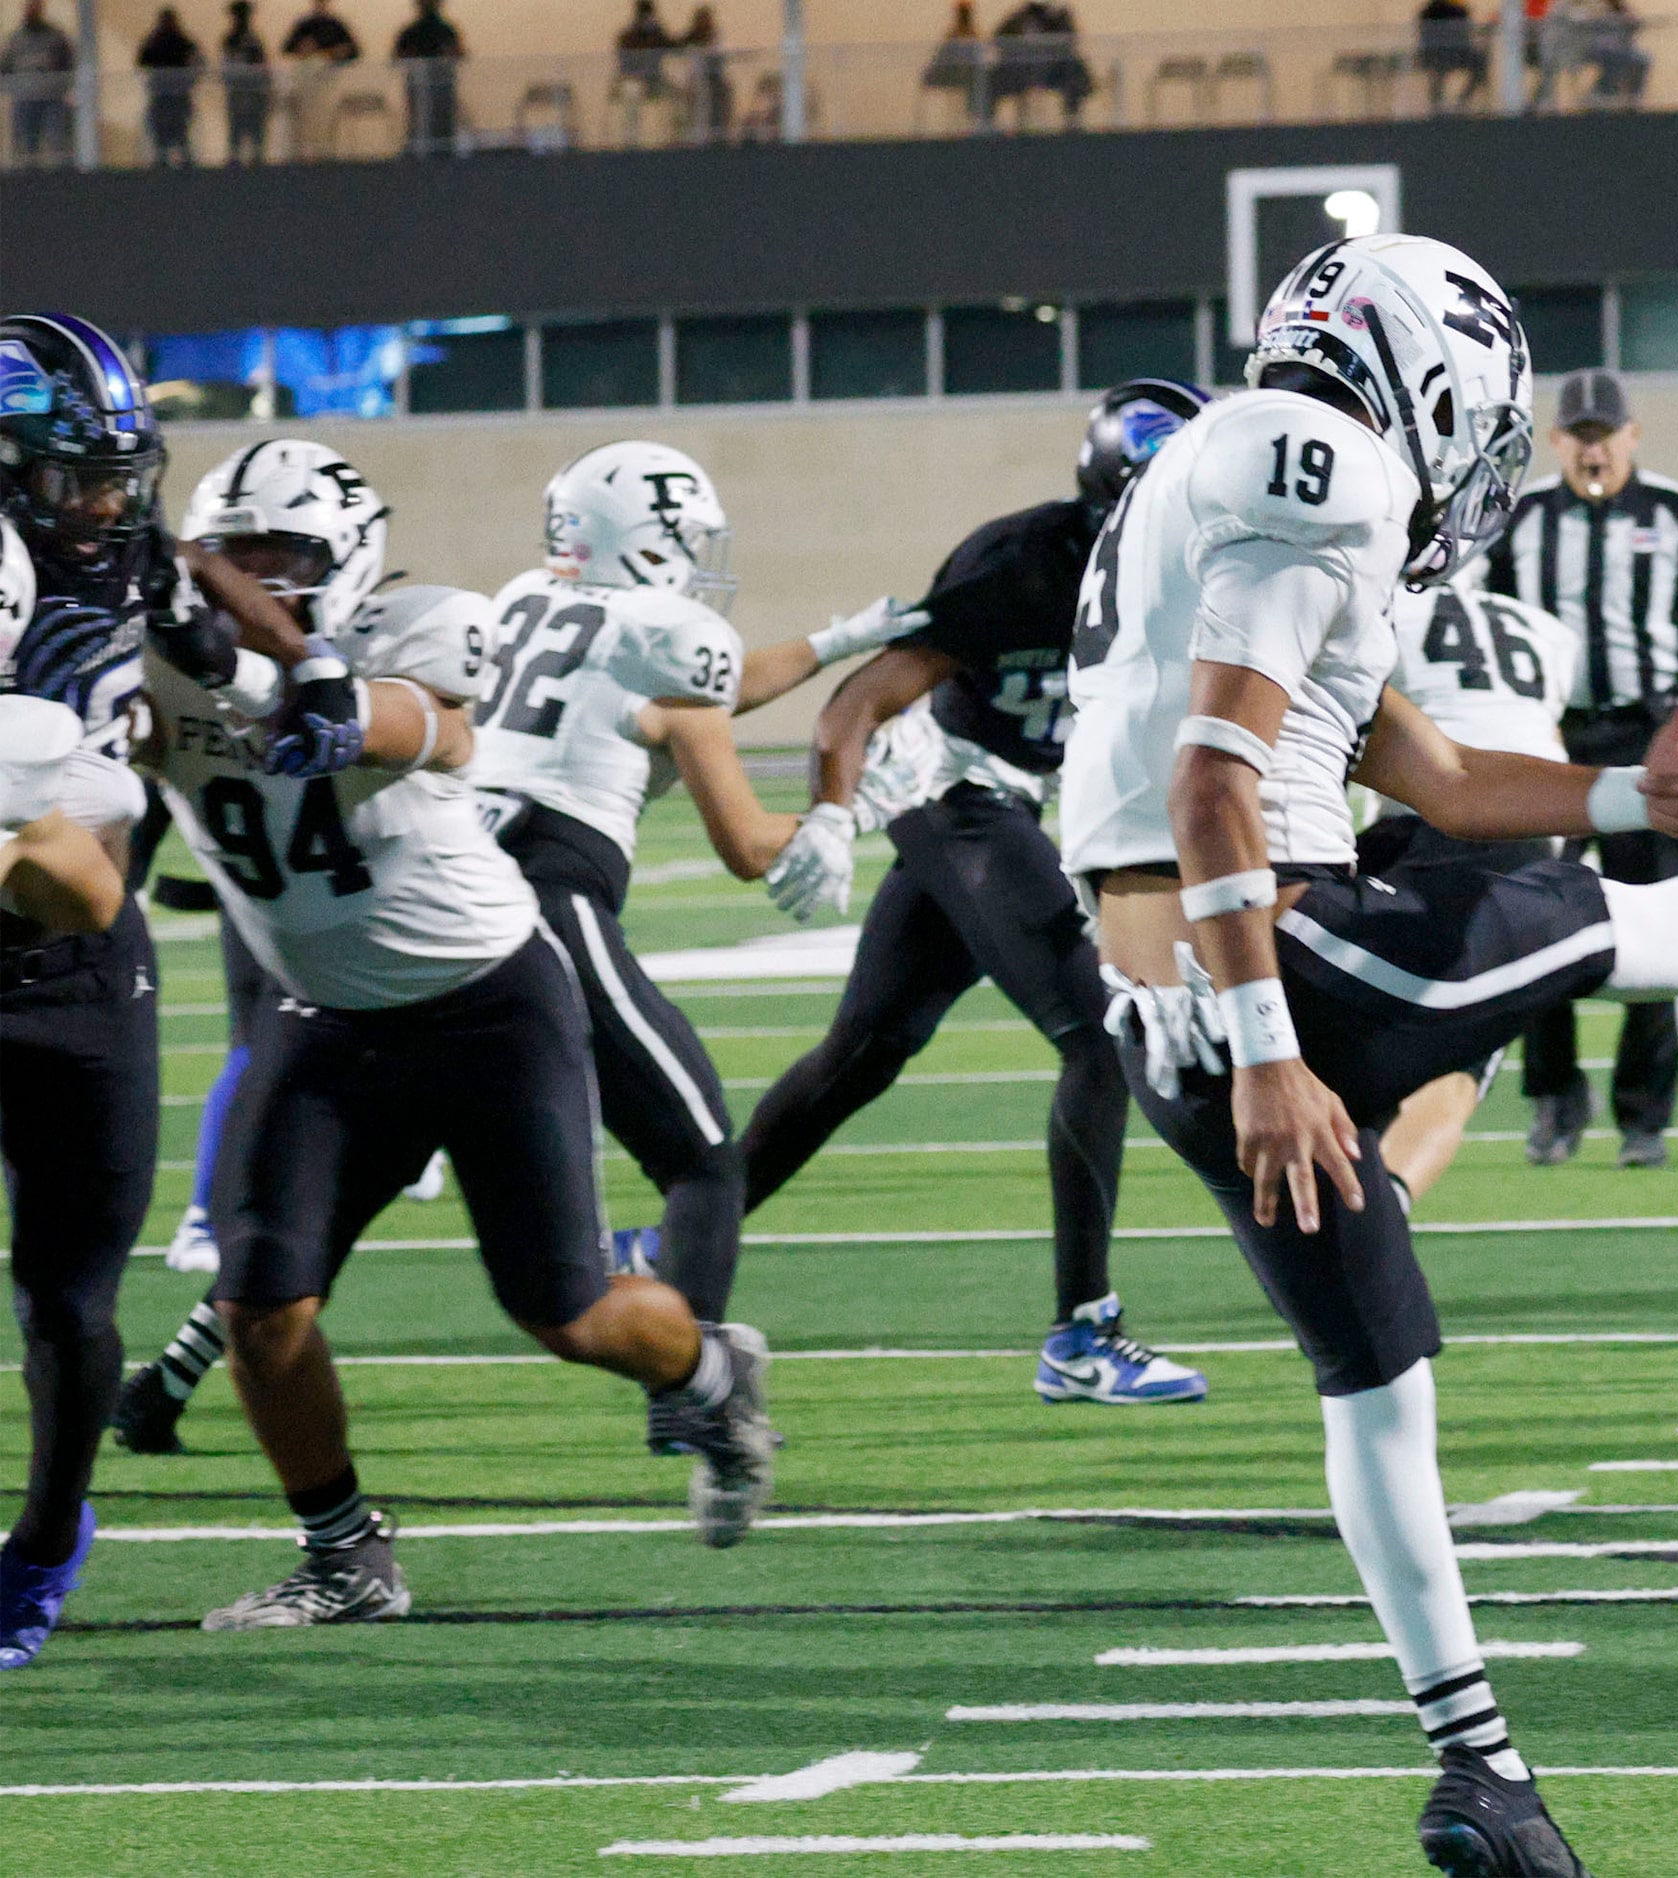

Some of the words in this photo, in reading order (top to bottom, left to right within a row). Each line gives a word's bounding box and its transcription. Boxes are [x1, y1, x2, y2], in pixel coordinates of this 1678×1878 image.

[1267, 433, 1335, 506] 19
[474, 594, 606, 739] 32
[691, 647, 733, 693] 32
[1422, 593, 1546, 701] 46
[201, 776, 373, 899] 94
